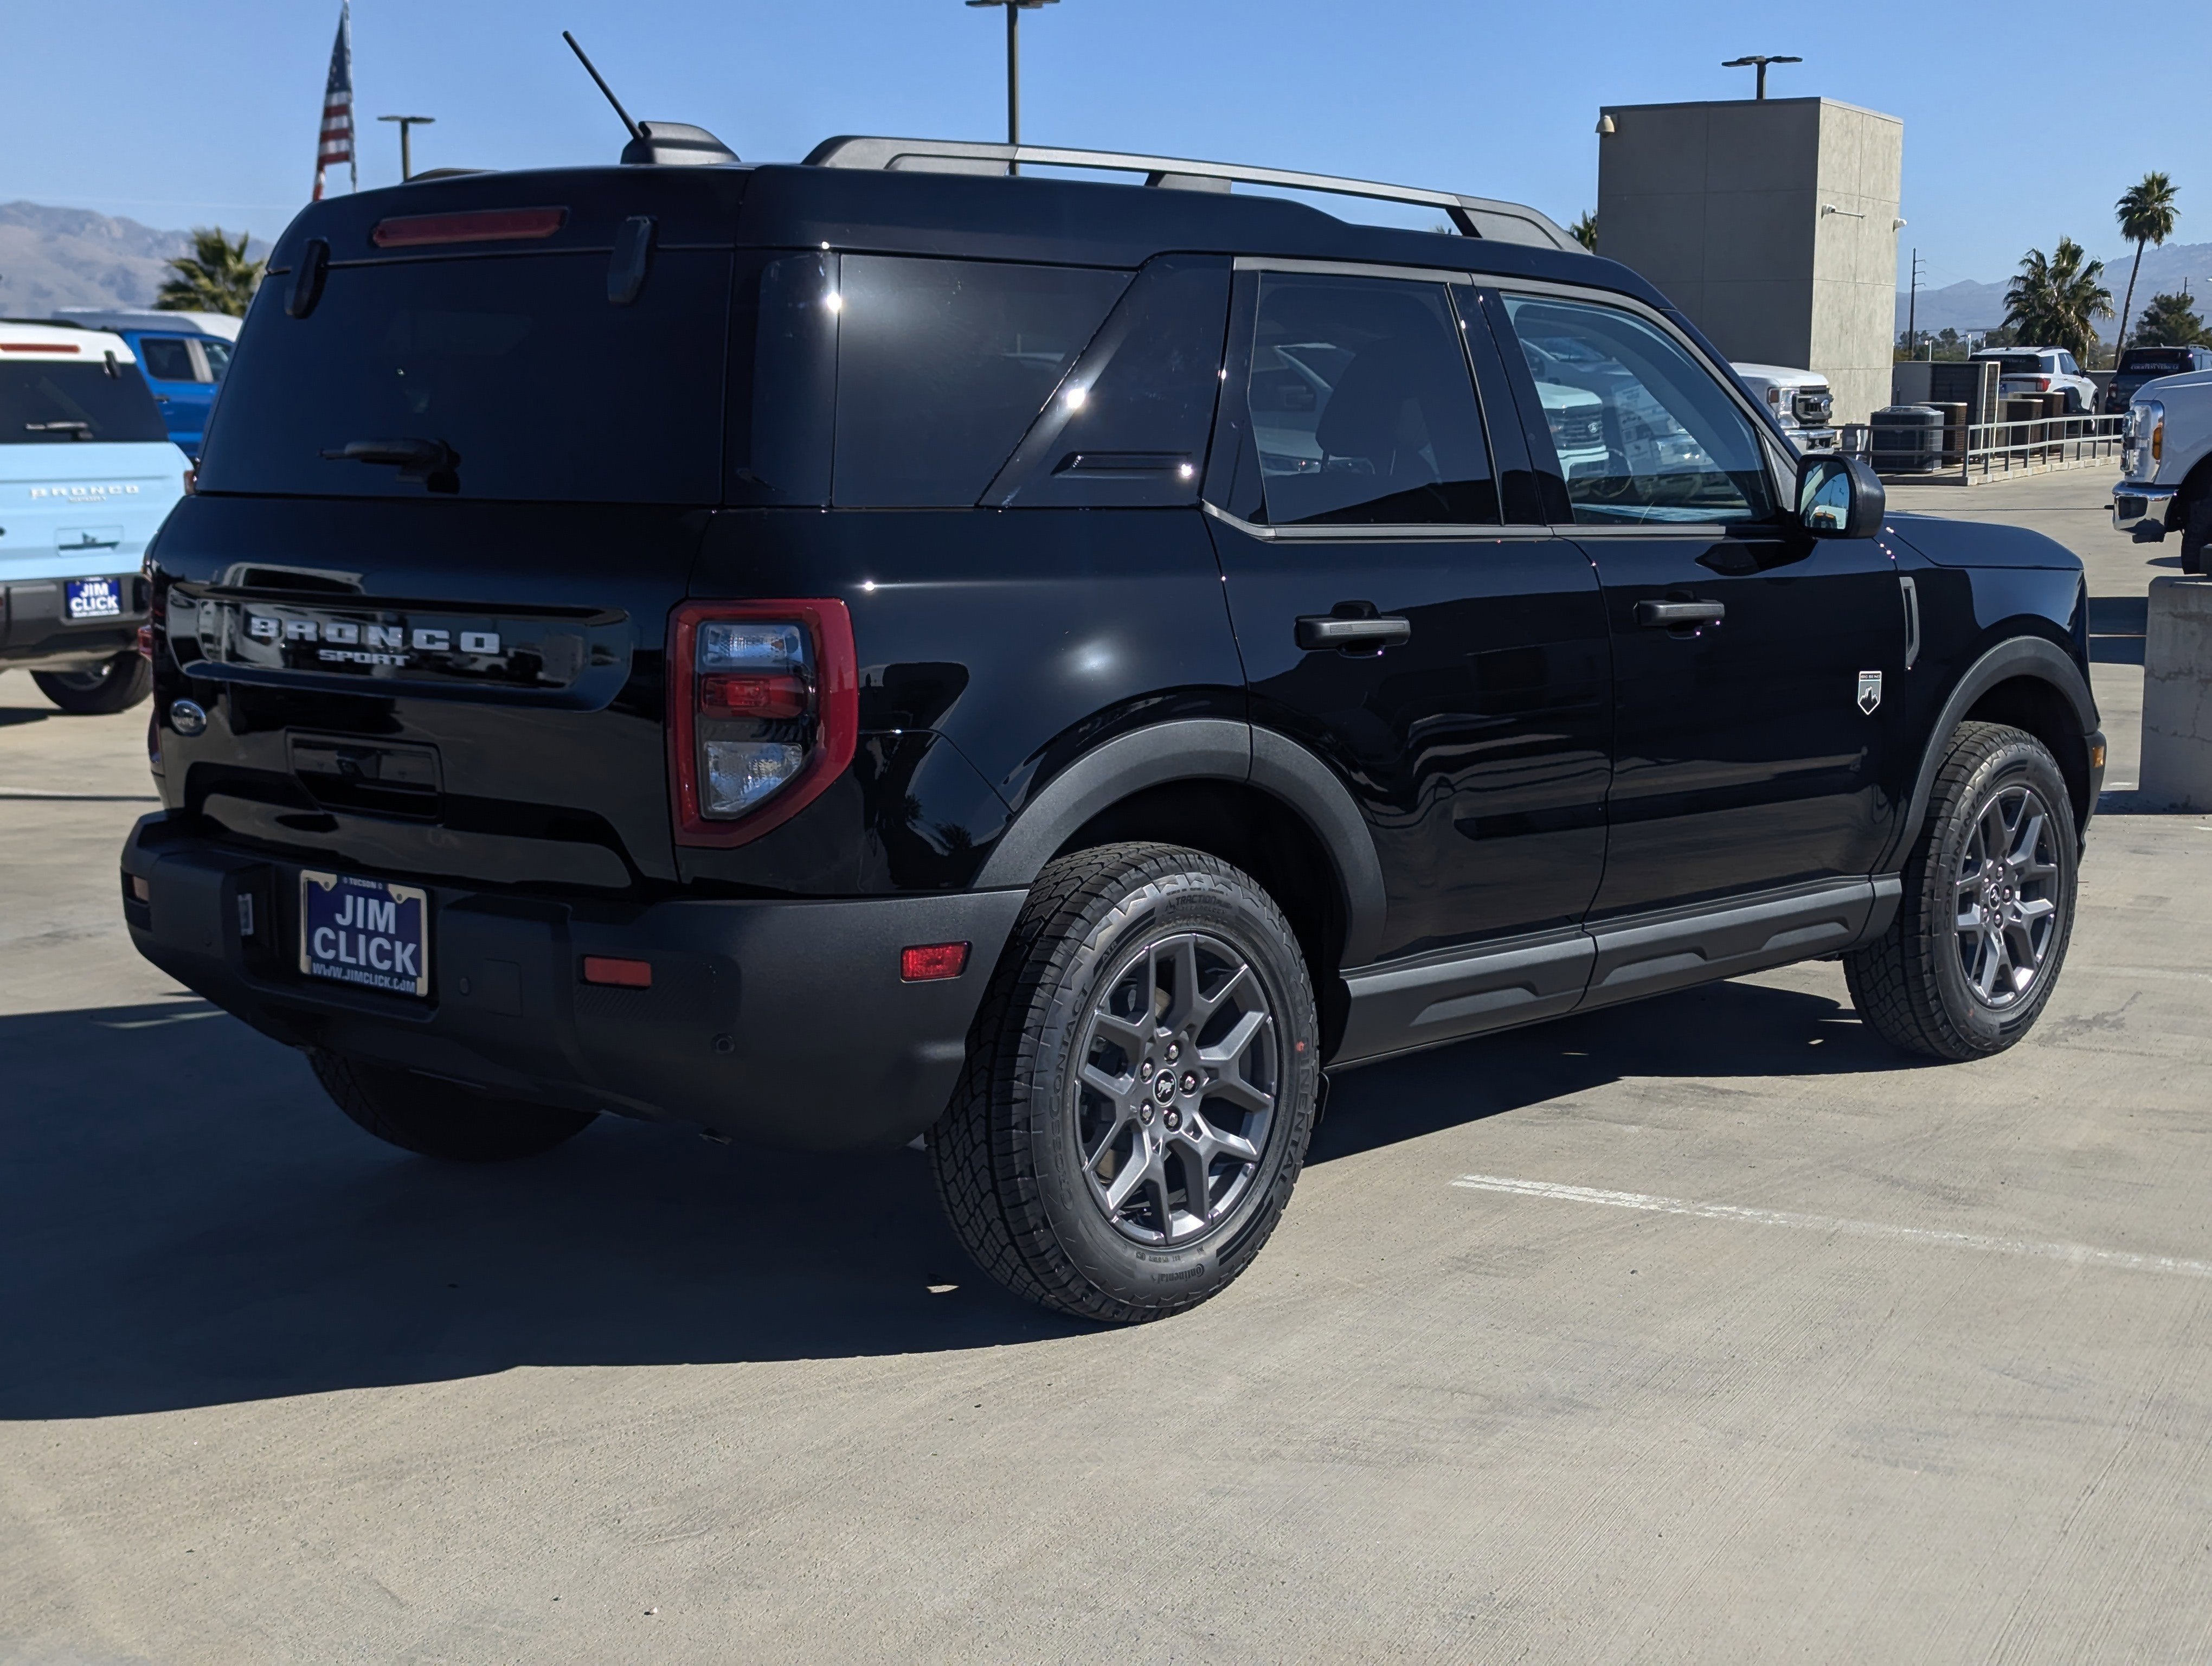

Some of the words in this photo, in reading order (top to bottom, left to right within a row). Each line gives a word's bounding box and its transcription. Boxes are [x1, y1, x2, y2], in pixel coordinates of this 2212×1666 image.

[70, 594, 119, 611] CLICK
[80, 582, 109, 597] JIM
[250, 617, 500, 653] BRONCO
[319, 650, 410, 666] SPORT
[335, 894, 396, 934] JIM
[313, 926, 418, 977] CLICK
[312, 962, 416, 993] WWW.JIMCLICK.COM
